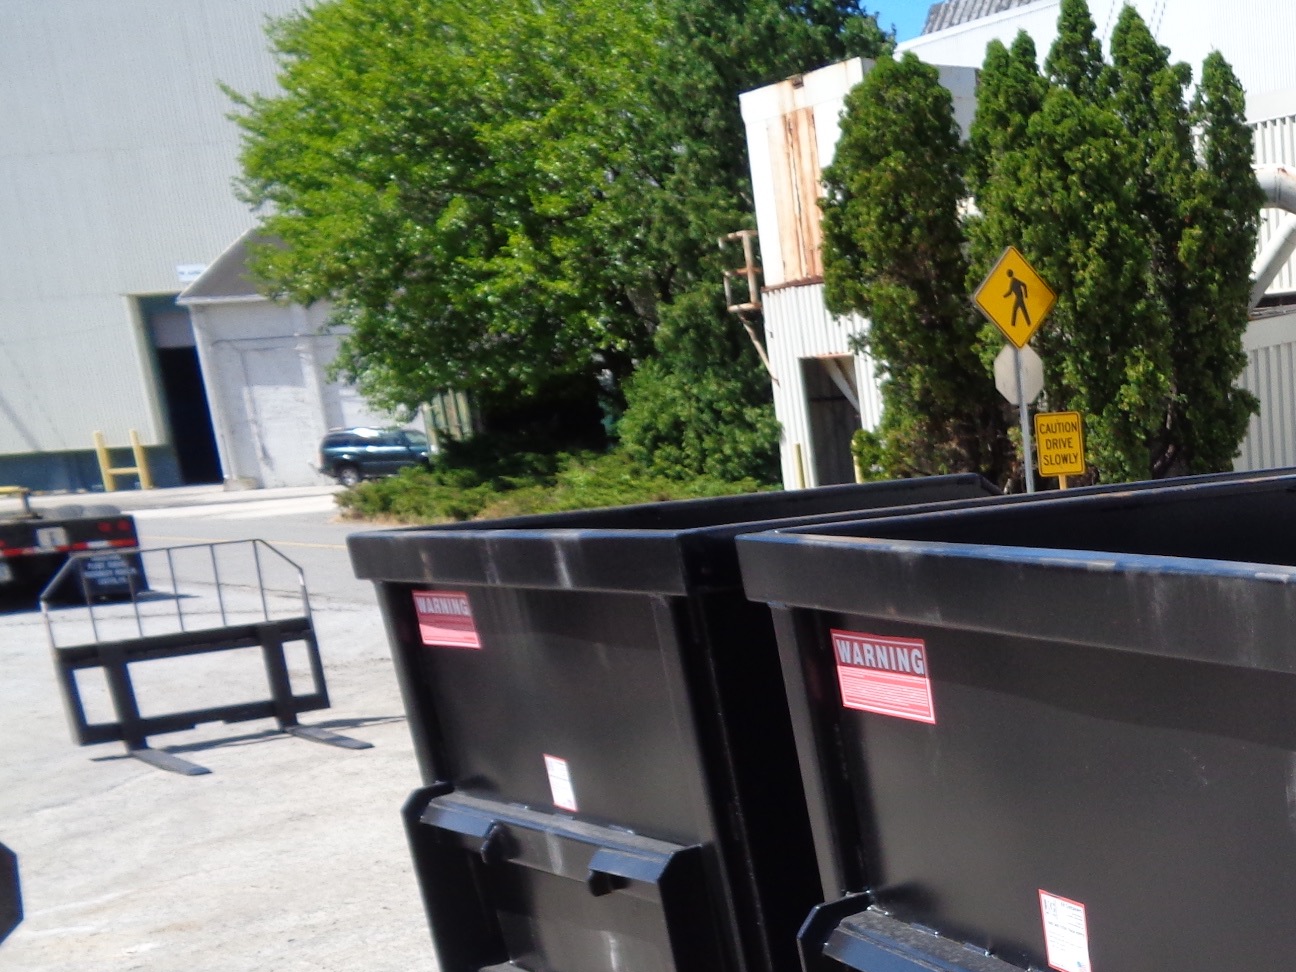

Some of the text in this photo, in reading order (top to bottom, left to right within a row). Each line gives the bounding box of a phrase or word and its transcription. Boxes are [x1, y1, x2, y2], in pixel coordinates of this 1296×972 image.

[1039, 421, 1078, 435] CAUTION
[1045, 437, 1074, 450] DRIVE
[1043, 452, 1080, 466] SLOWLY
[416, 597, 472, 616] WARNING
[836, 639, 925, 675] WARNING
